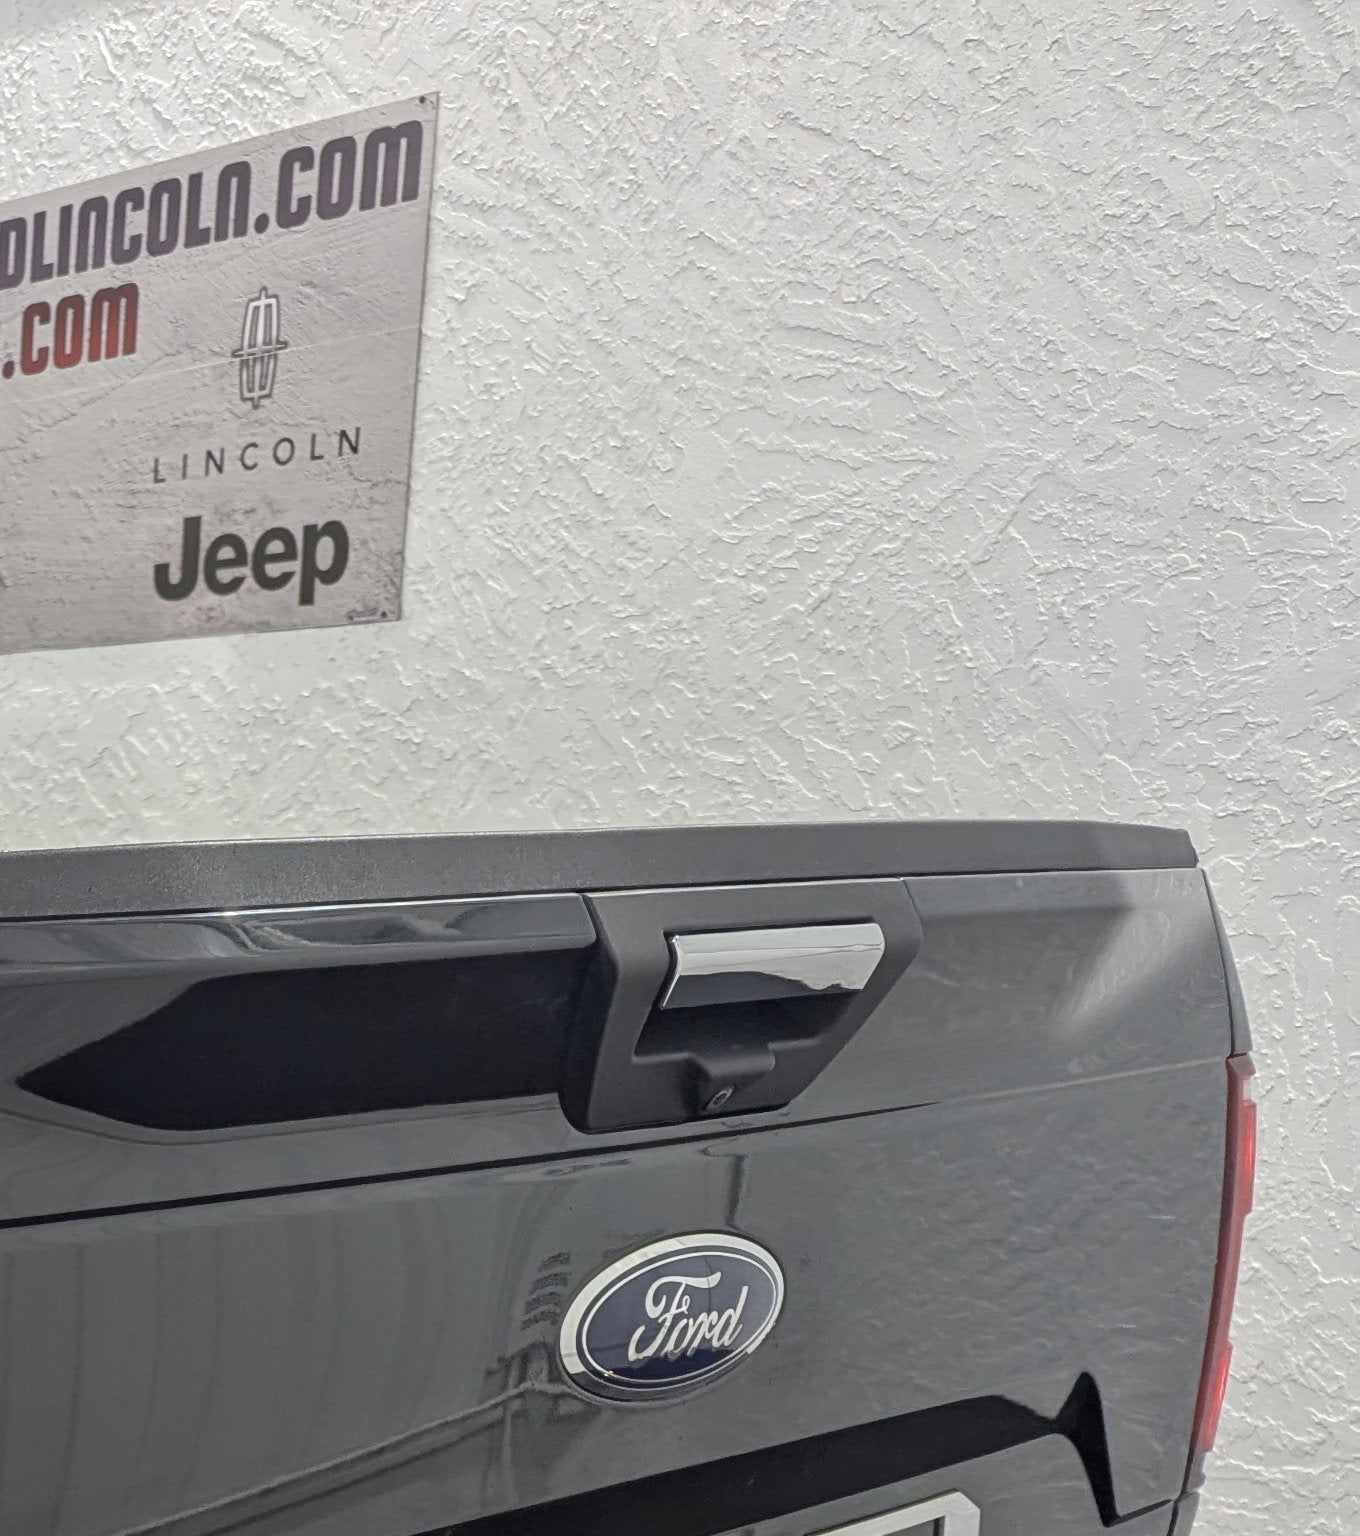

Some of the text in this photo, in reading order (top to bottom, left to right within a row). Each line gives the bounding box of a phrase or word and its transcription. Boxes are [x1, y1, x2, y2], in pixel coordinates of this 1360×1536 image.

[152, 426, 361, 484] LINCOLN
[153, 515, 350, 607] Jeep
[627, 1270, 749, 1363] Ford
